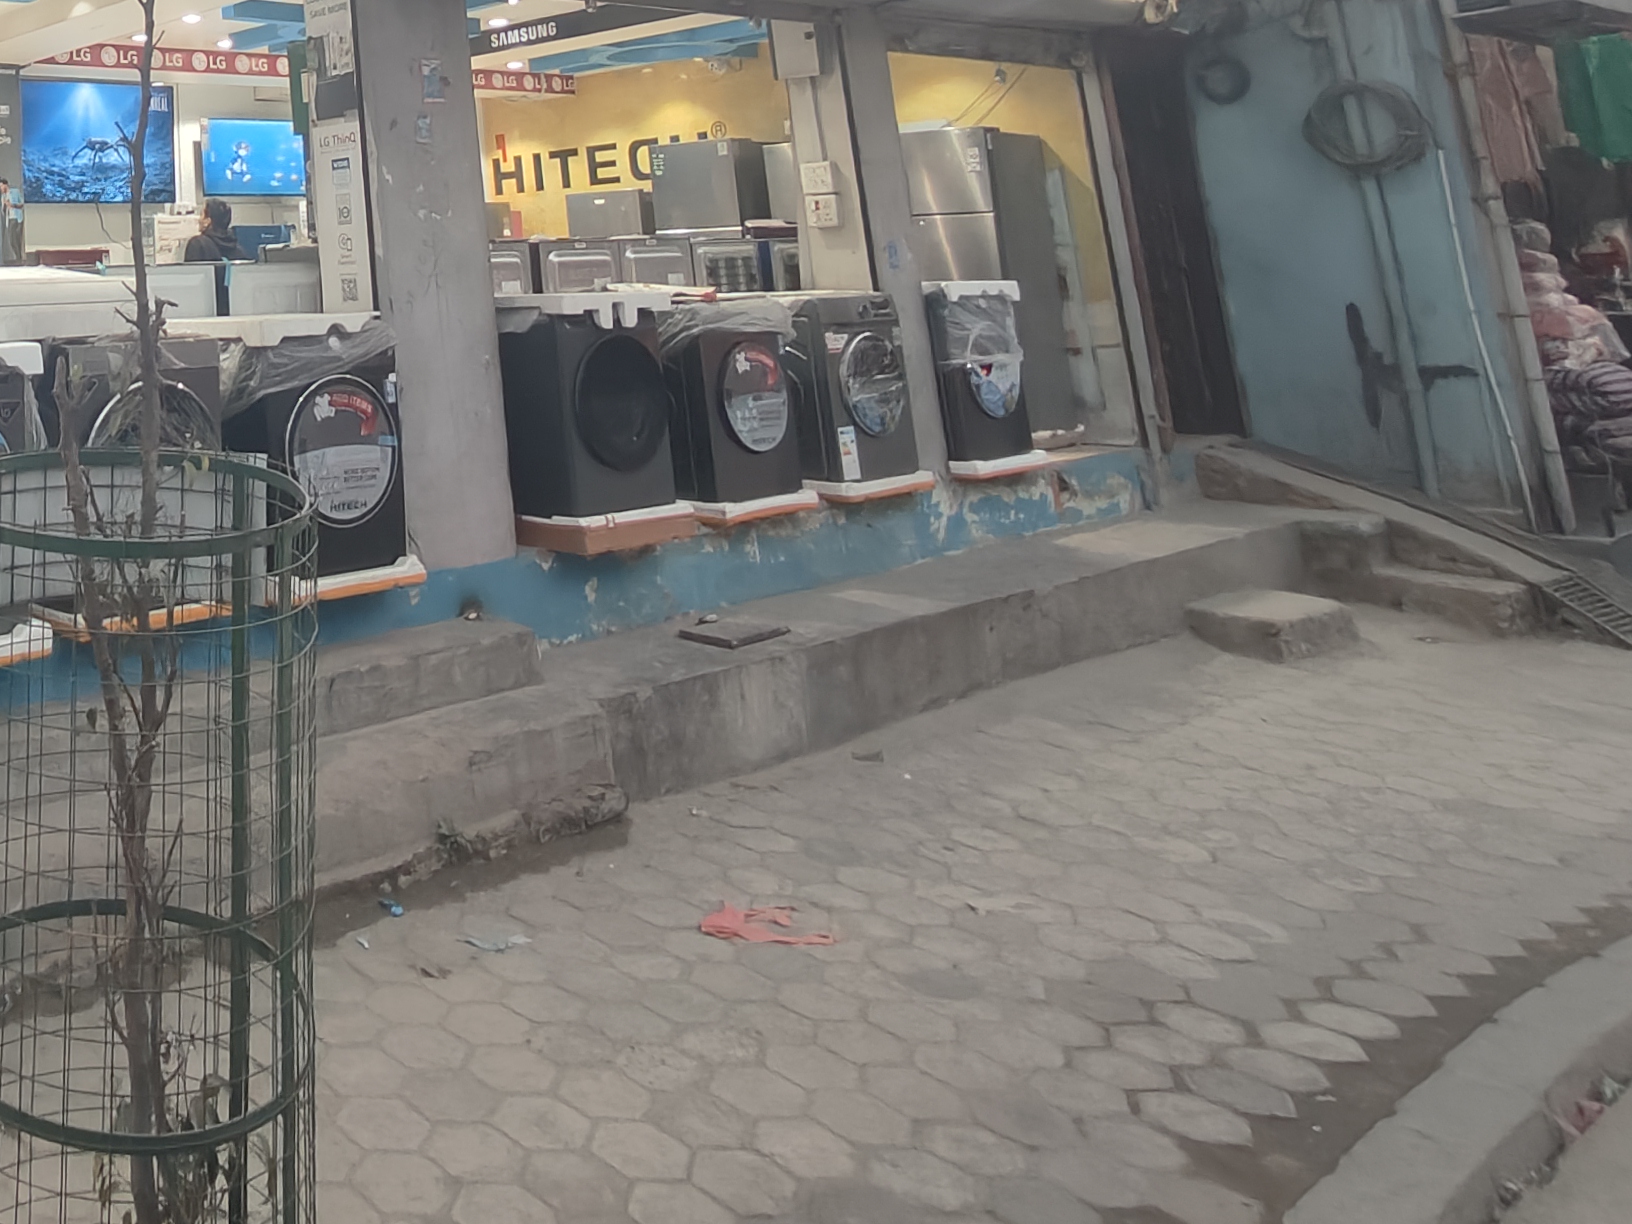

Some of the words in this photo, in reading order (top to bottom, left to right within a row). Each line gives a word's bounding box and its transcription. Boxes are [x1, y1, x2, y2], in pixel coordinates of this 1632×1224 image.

[490, 21, 558, 48] SAMSUNG
[72, 47, 91, 62] LG
[119, 50, 138, 64] LG
[165, 53, 183, 67] LG
[209, 56, 227, 70] LG
[251, 57, 268, 72] LG
[503, 75, 517, 87] LG
[563, 78, 575, 90] LG
[319, 134, 330, 149] LG
[332, 131, 356, 146] ThinQ
[492, 131, 709, 196] HITEC
[329, 498, 368, 513] HITECH
